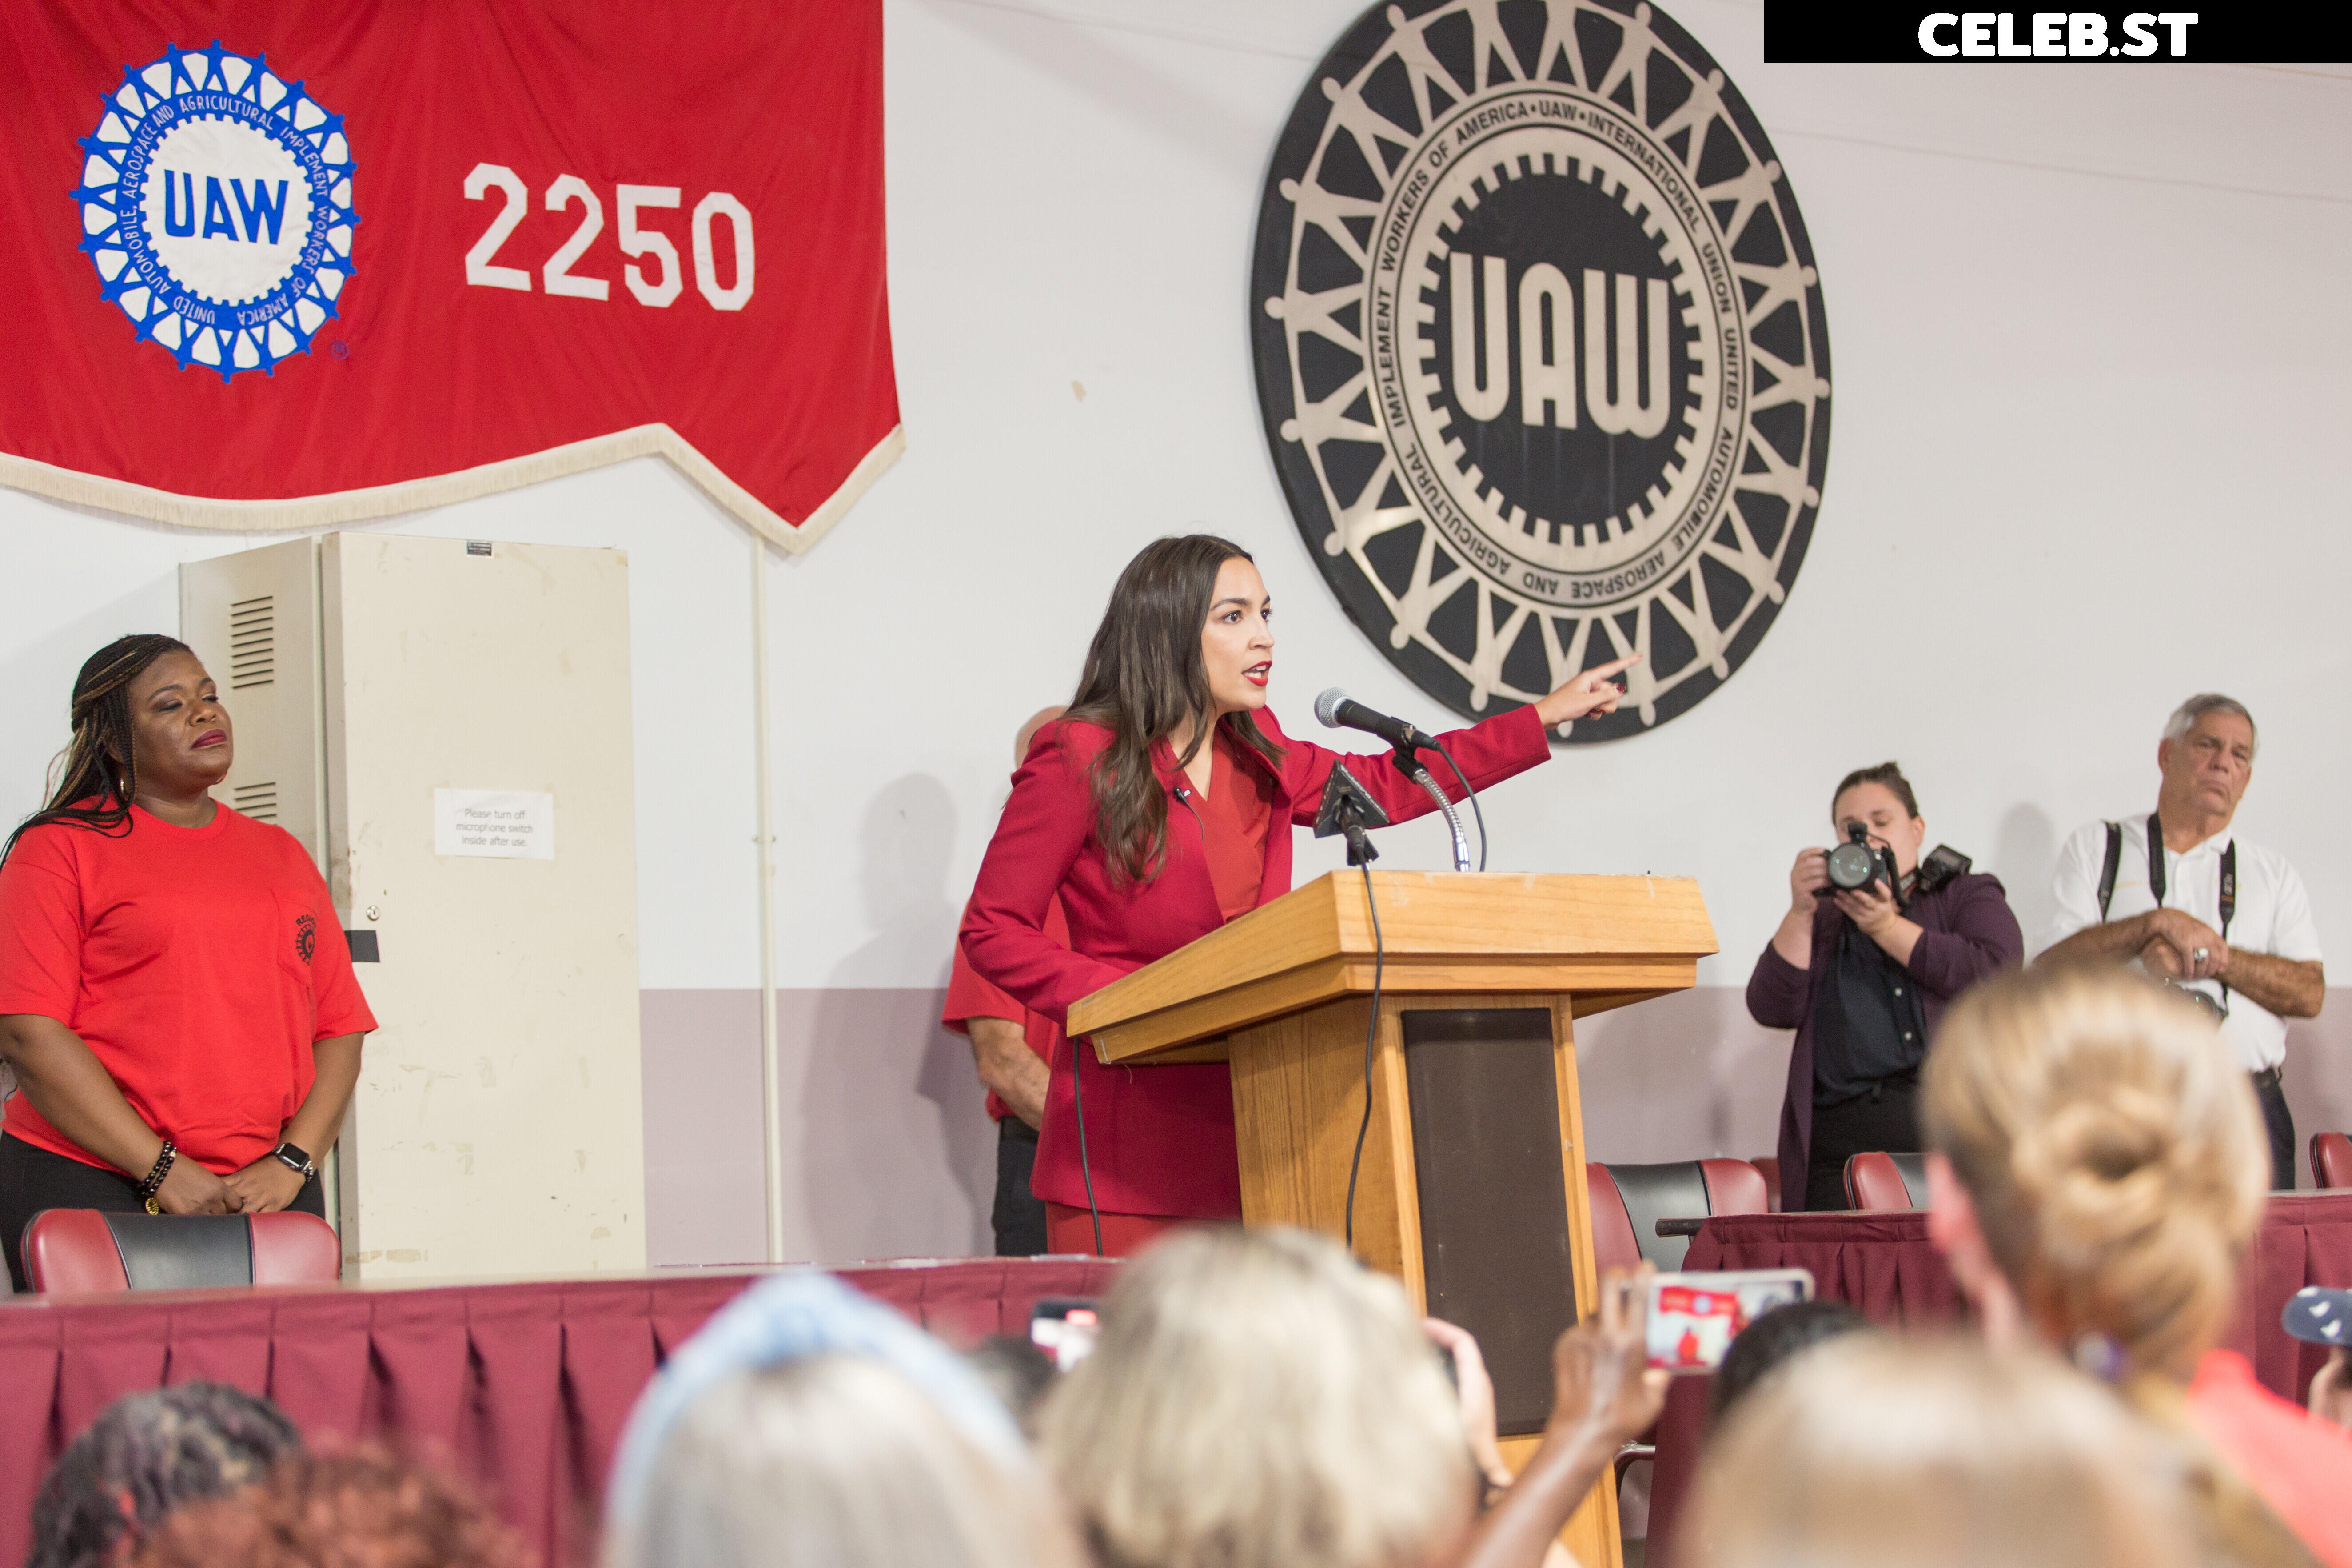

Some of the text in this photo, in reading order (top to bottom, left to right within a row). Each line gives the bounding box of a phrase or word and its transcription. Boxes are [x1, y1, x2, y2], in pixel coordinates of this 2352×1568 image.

[152, 105, 174, 127] AND
[179, 96, 273, 130] AGRICULTURAL
[122, 122, 157, 199] AEROSPACE
[280, 127, 328, 196] IMPLEMENT
[164, 169, 289, 245] UAW
[302, 206, 328, 275] WORKERS
[464, 162, 755, 311] 2250
[291, 276, 306, 298] OF
[173, 296, 215, 324] UNITED
[237, 293, 289, 326] AMERICA
[1377, 100, 1739, 598] UAW INTERNATIONAL UNION UNITED AUTOMOBILE AEROSPACE AND AGRICULTURAL IMPLEMENT WORKERS OF AMERICA
[1449, 251, 1670, 439] UAW
[456, 823, 533, 834] microphone switch
[465, 808, 526, 819] Please turn off
[462, 836, 486, 845] inside
[490, 836, 509, 846] after
